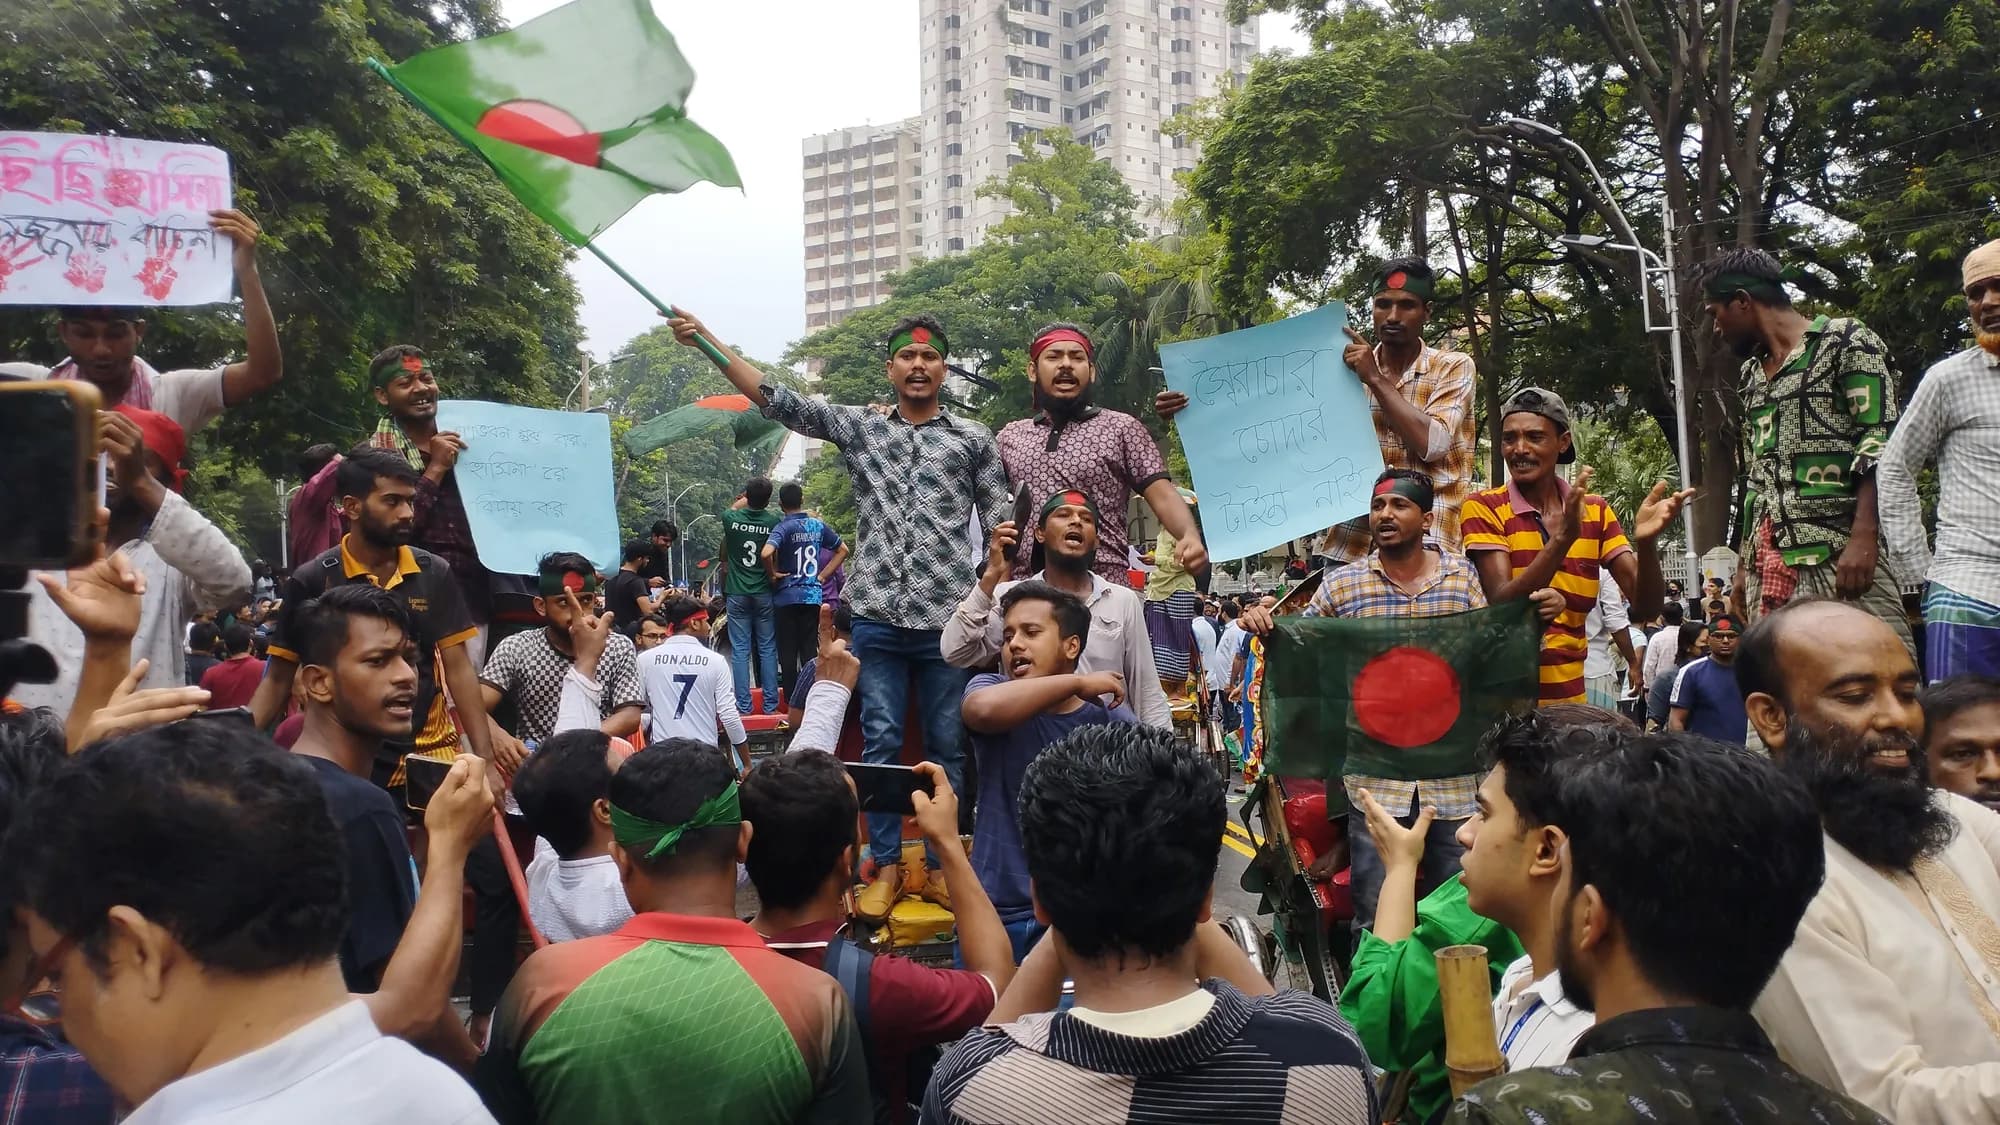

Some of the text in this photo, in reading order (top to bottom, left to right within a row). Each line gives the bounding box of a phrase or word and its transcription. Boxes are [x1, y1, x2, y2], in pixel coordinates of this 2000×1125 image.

[731, 521, 773, 536] ROBIUL
[742, 540, 758, 568] 3
[793, 545, 819, 579] 18
[654, 653, 709, 667] RONALDO
[672, 673, 699, 720] 7
